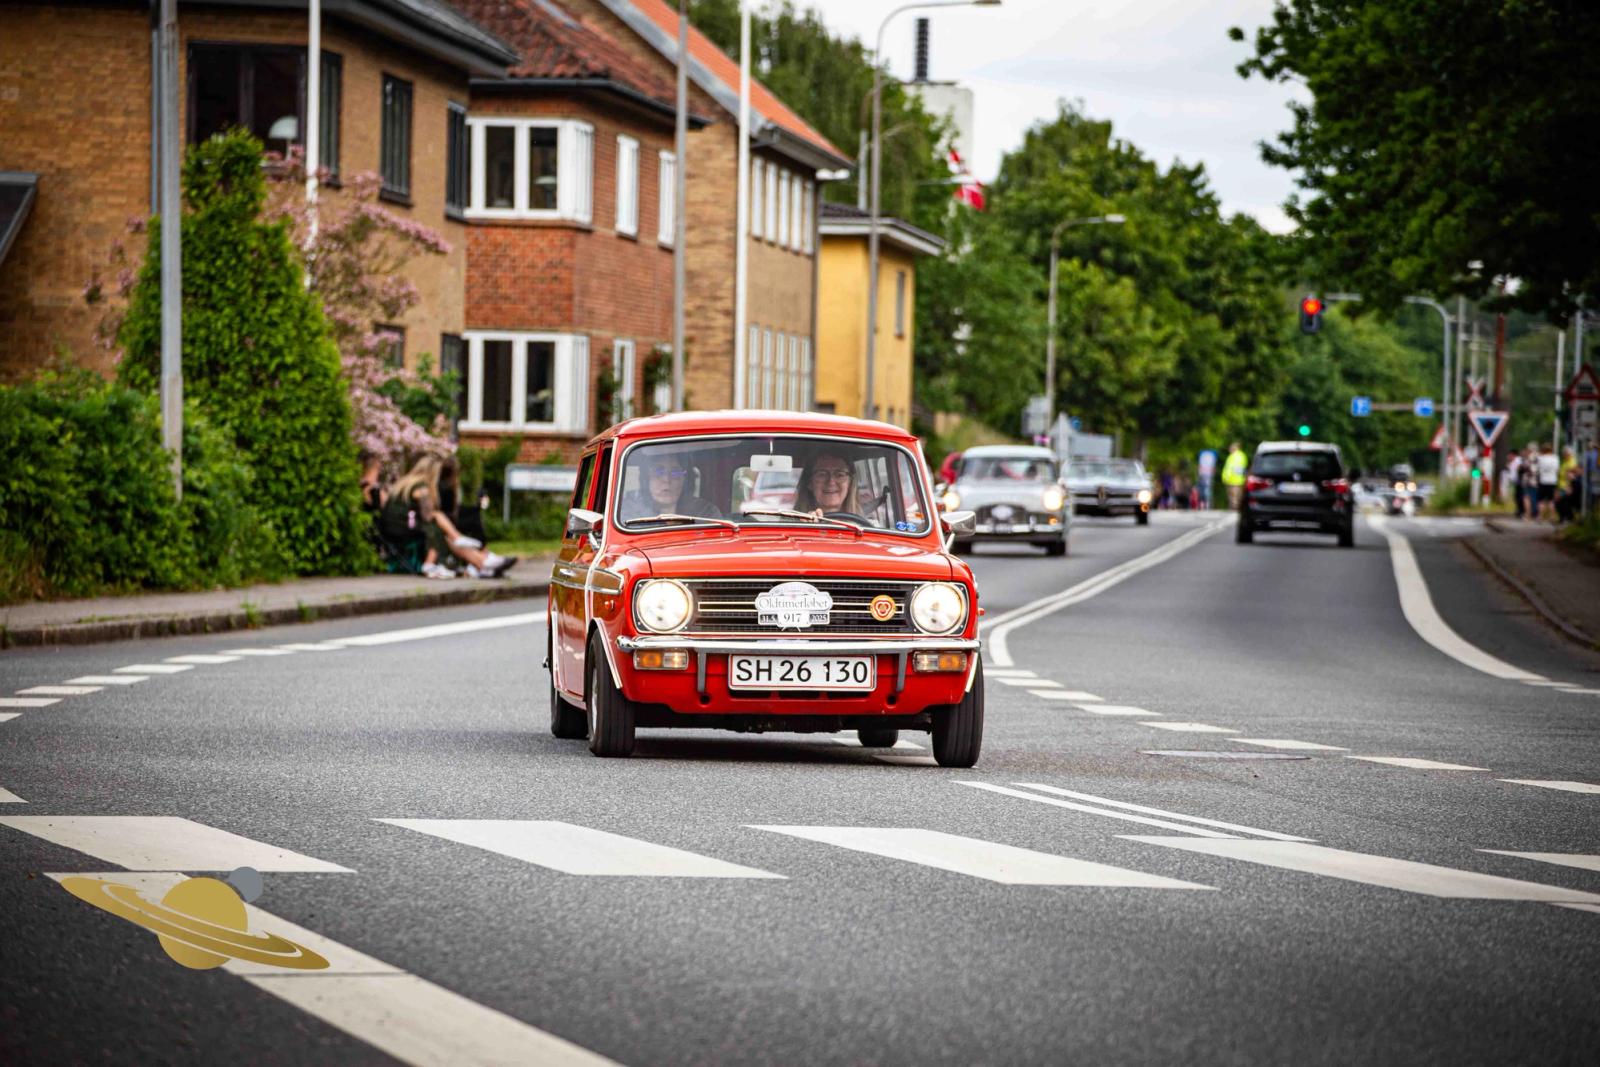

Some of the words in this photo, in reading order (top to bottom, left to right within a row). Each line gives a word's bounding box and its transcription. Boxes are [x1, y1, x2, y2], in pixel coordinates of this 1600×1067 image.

[783, 613, 802, 623] 917
[811, 614, 828, 623] 2025
[736, 659, 772, 681] SH
[779, 660, 812, 682] 26
[823, 660, 868, 683] 130
